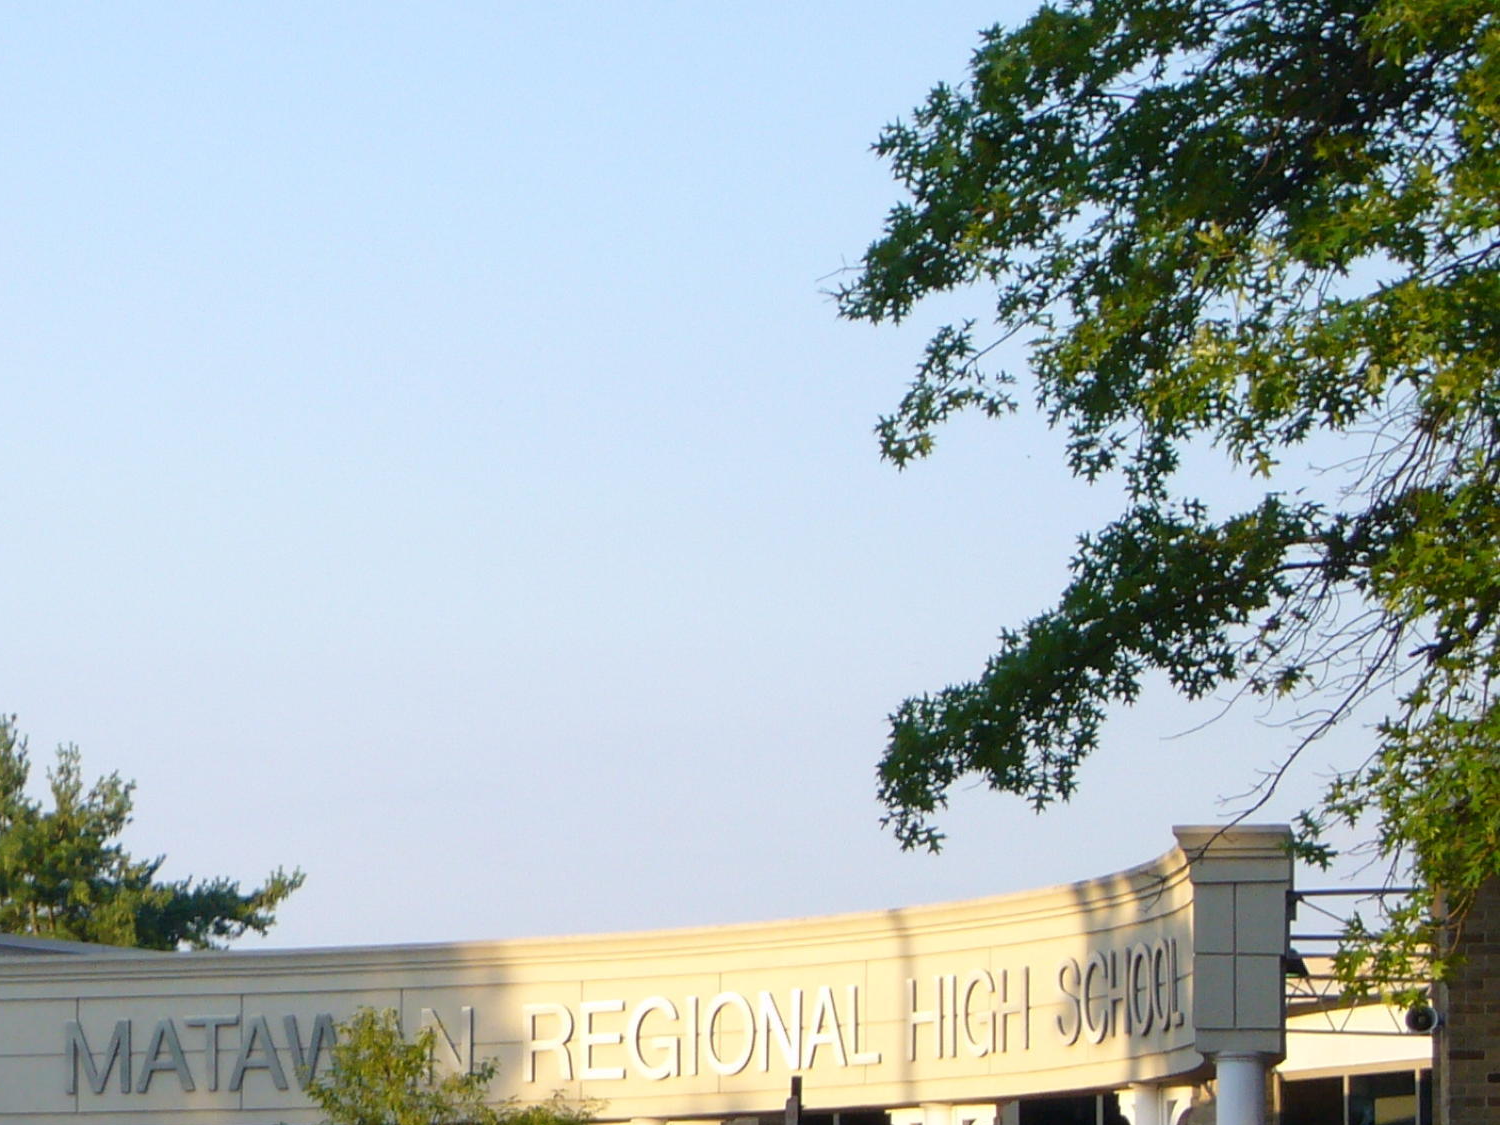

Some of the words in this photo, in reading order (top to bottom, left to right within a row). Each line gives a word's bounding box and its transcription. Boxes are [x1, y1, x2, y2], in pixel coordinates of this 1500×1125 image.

[65, 1006, 474, 1094] MATAWN
[521, 984, 882, 1083] REGIONAL
[907, 966, 1030, 1062] HIGH
[1057, 936, 1185, 1046] SCHOOL
